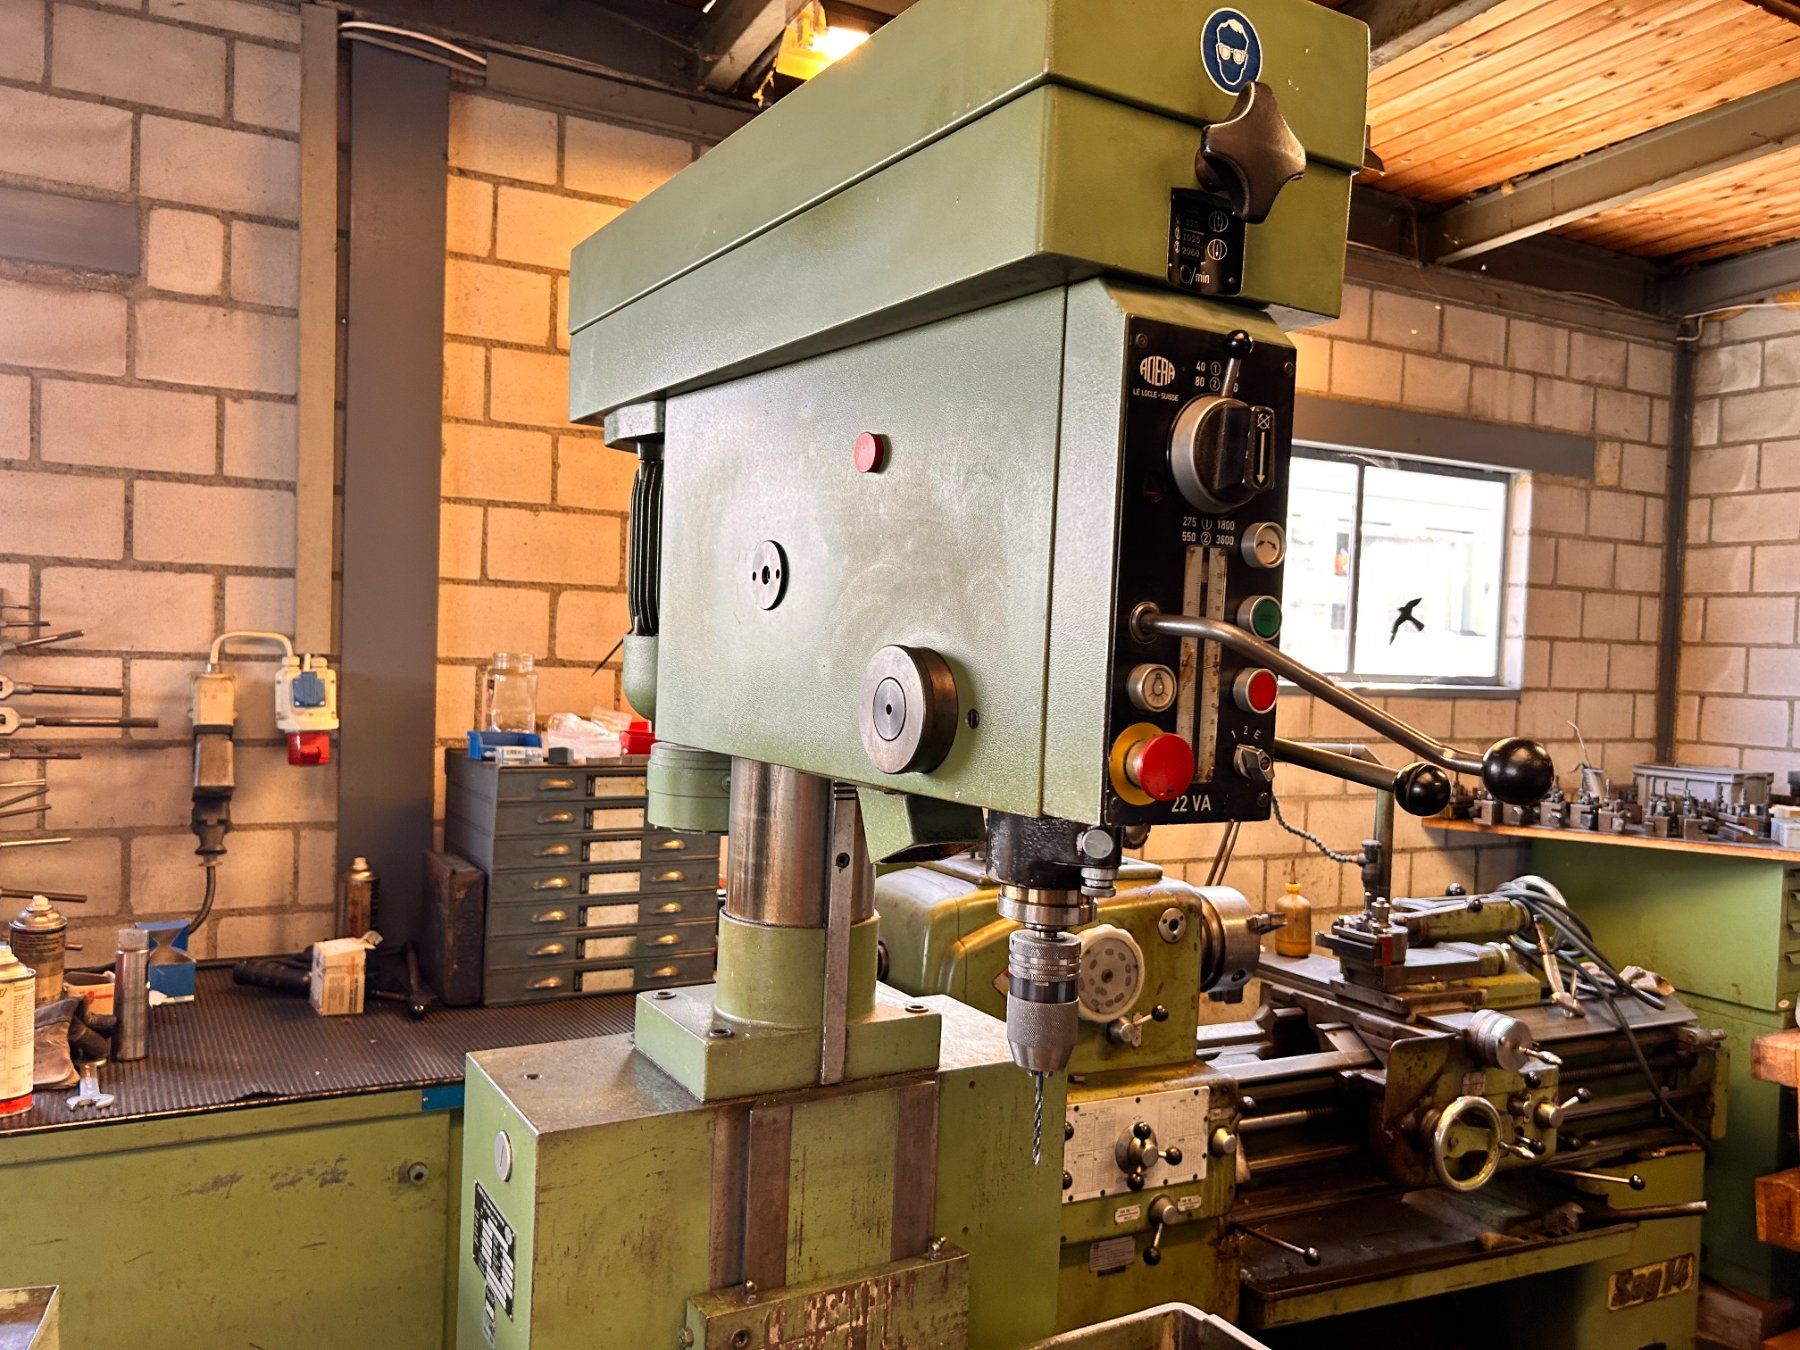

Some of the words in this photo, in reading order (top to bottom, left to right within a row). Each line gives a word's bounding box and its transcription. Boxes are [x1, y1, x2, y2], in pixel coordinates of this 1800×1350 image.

[1139, 355, 1176, 387] ACIERA
[1196, 361, 1206, 372] 40
[1195, 376, 1205, 388] 80
[1132, 388, 1141, 396] LE
[1183, 516, 1197, 527] 275
[1217, 520, 1235, 531] 1800
[1182, 531, 1196, 542] 550
[1216, 534, 1234, 545] 3600
[1193, 795, 1211, 812] VA
